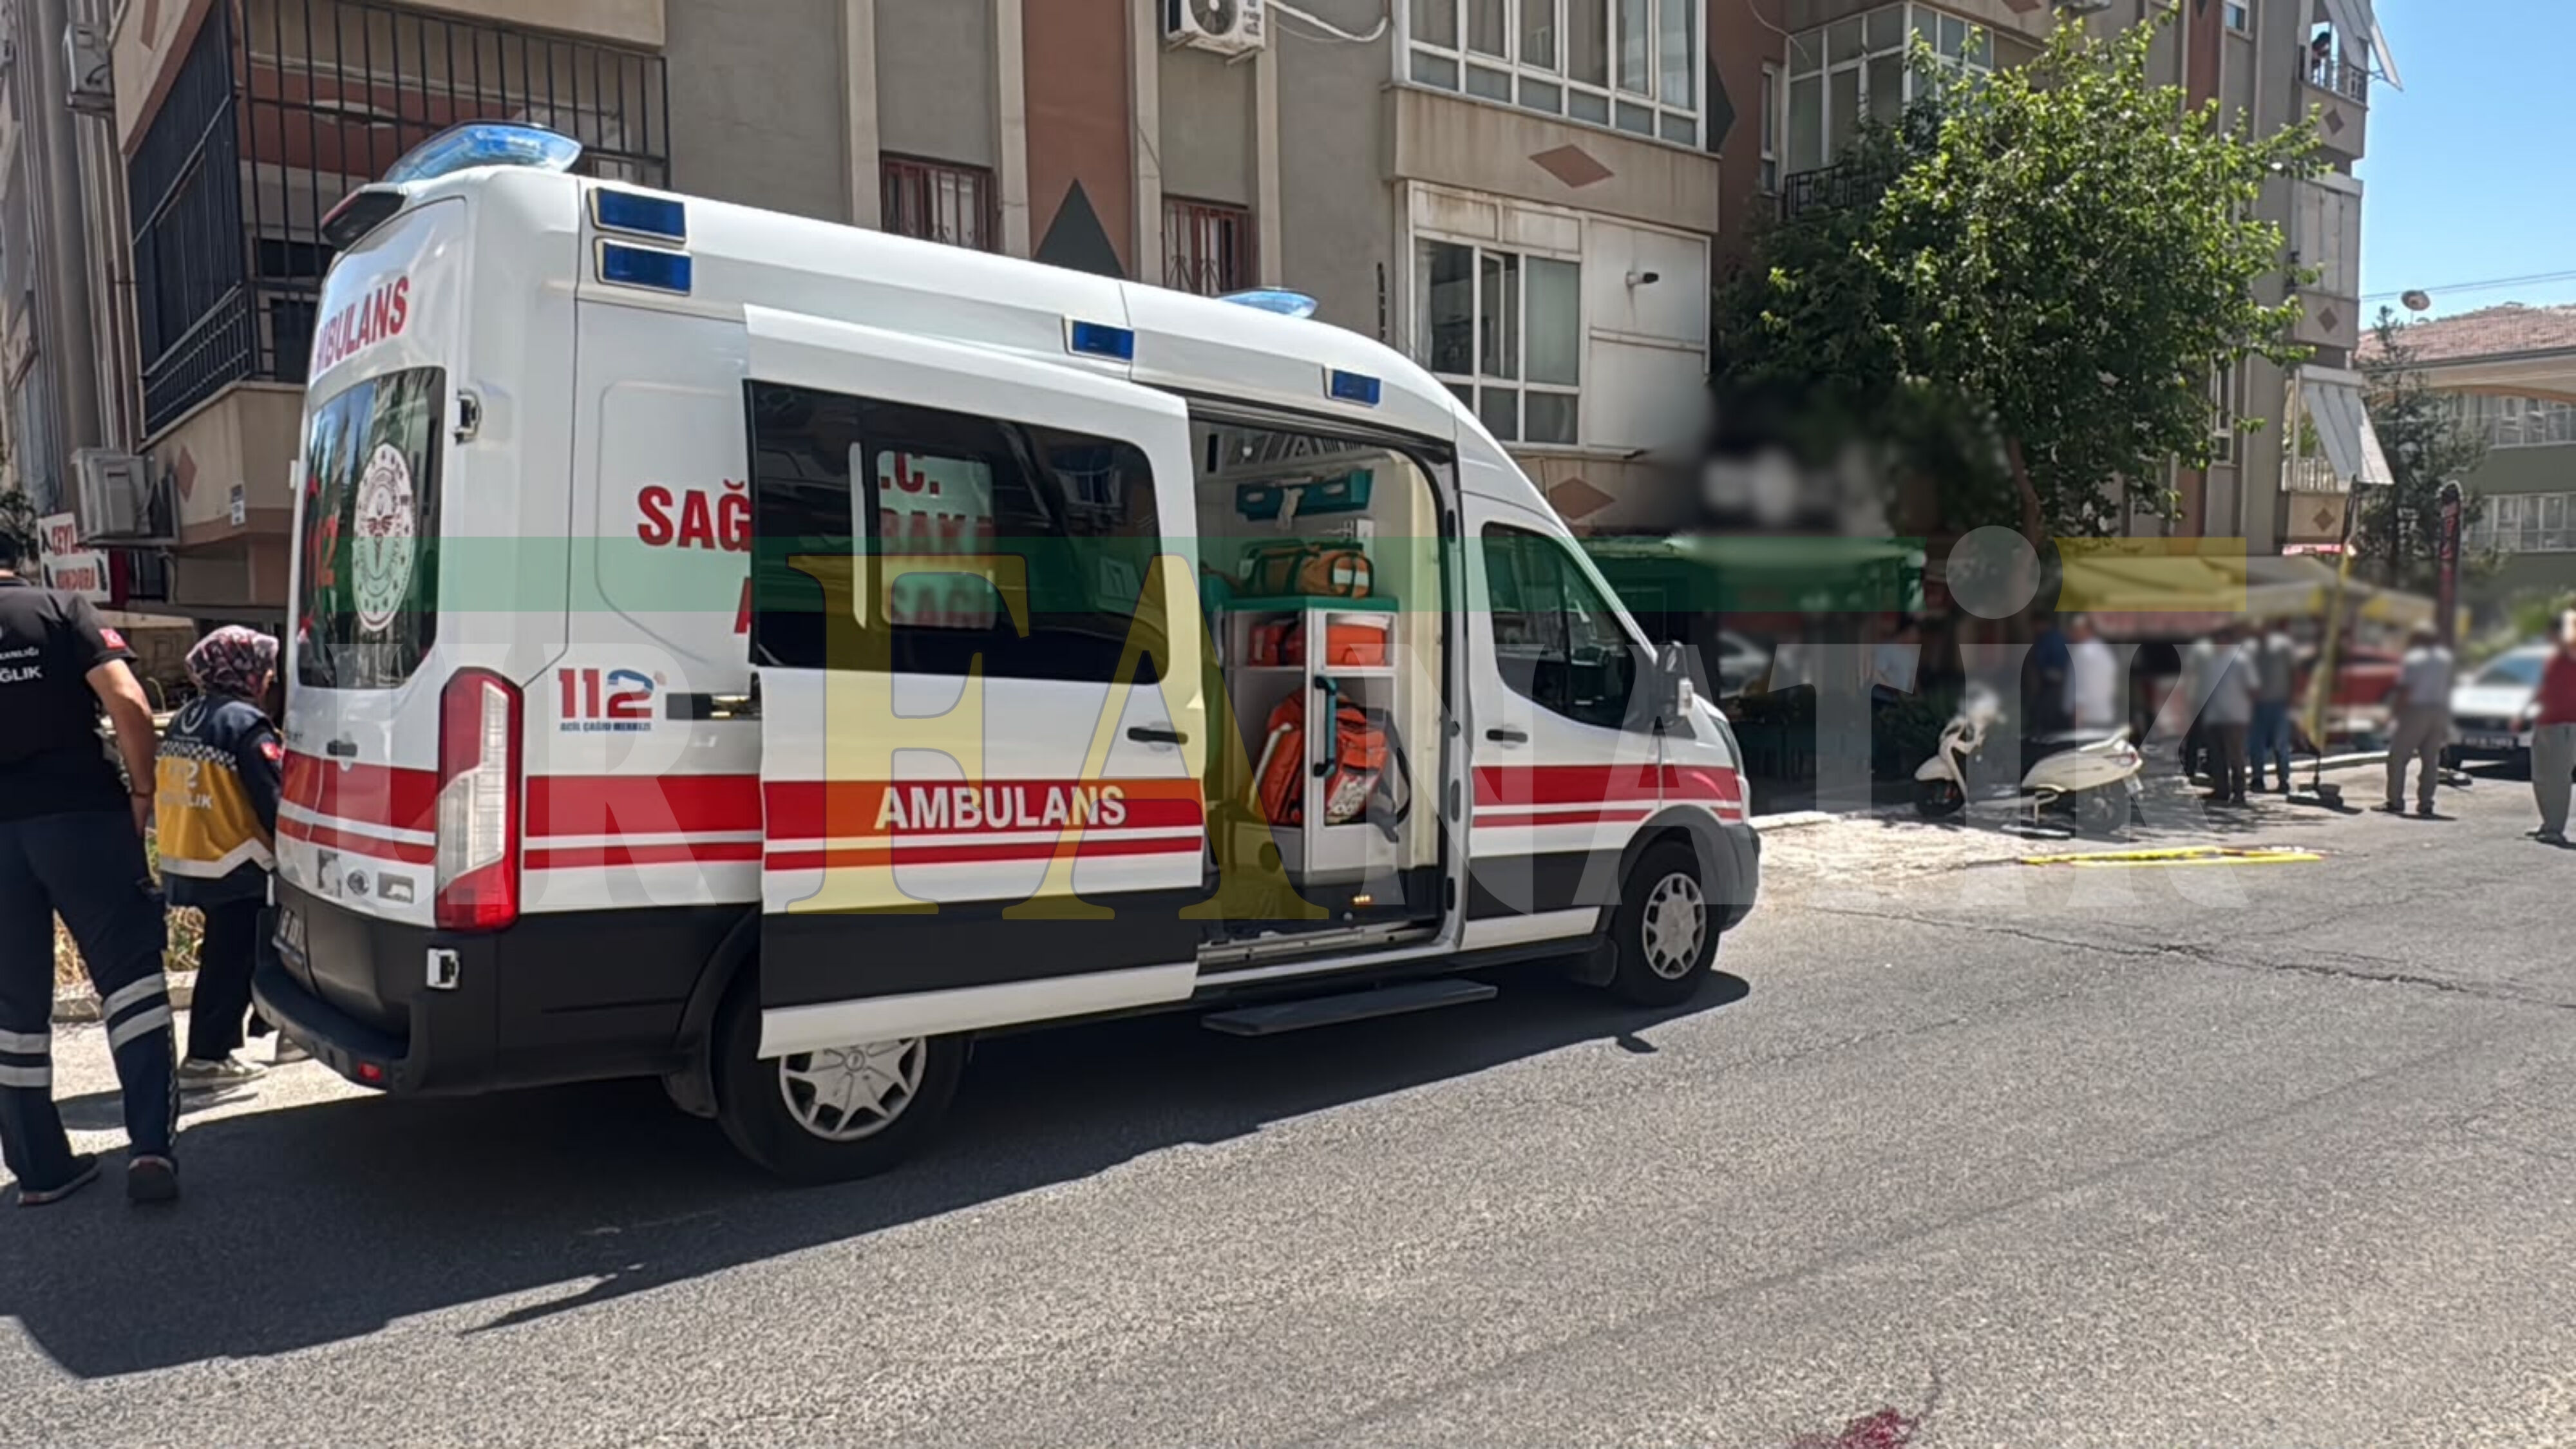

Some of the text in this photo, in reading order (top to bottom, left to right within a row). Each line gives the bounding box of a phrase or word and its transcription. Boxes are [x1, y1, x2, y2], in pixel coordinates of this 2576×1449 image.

[316, 276, 409, 374] MBULANS
[638, 479, 752, 553] SAĞ
[558, 668, 655, 719] 112
[874, 784, 1128, 831] AMBULANS
